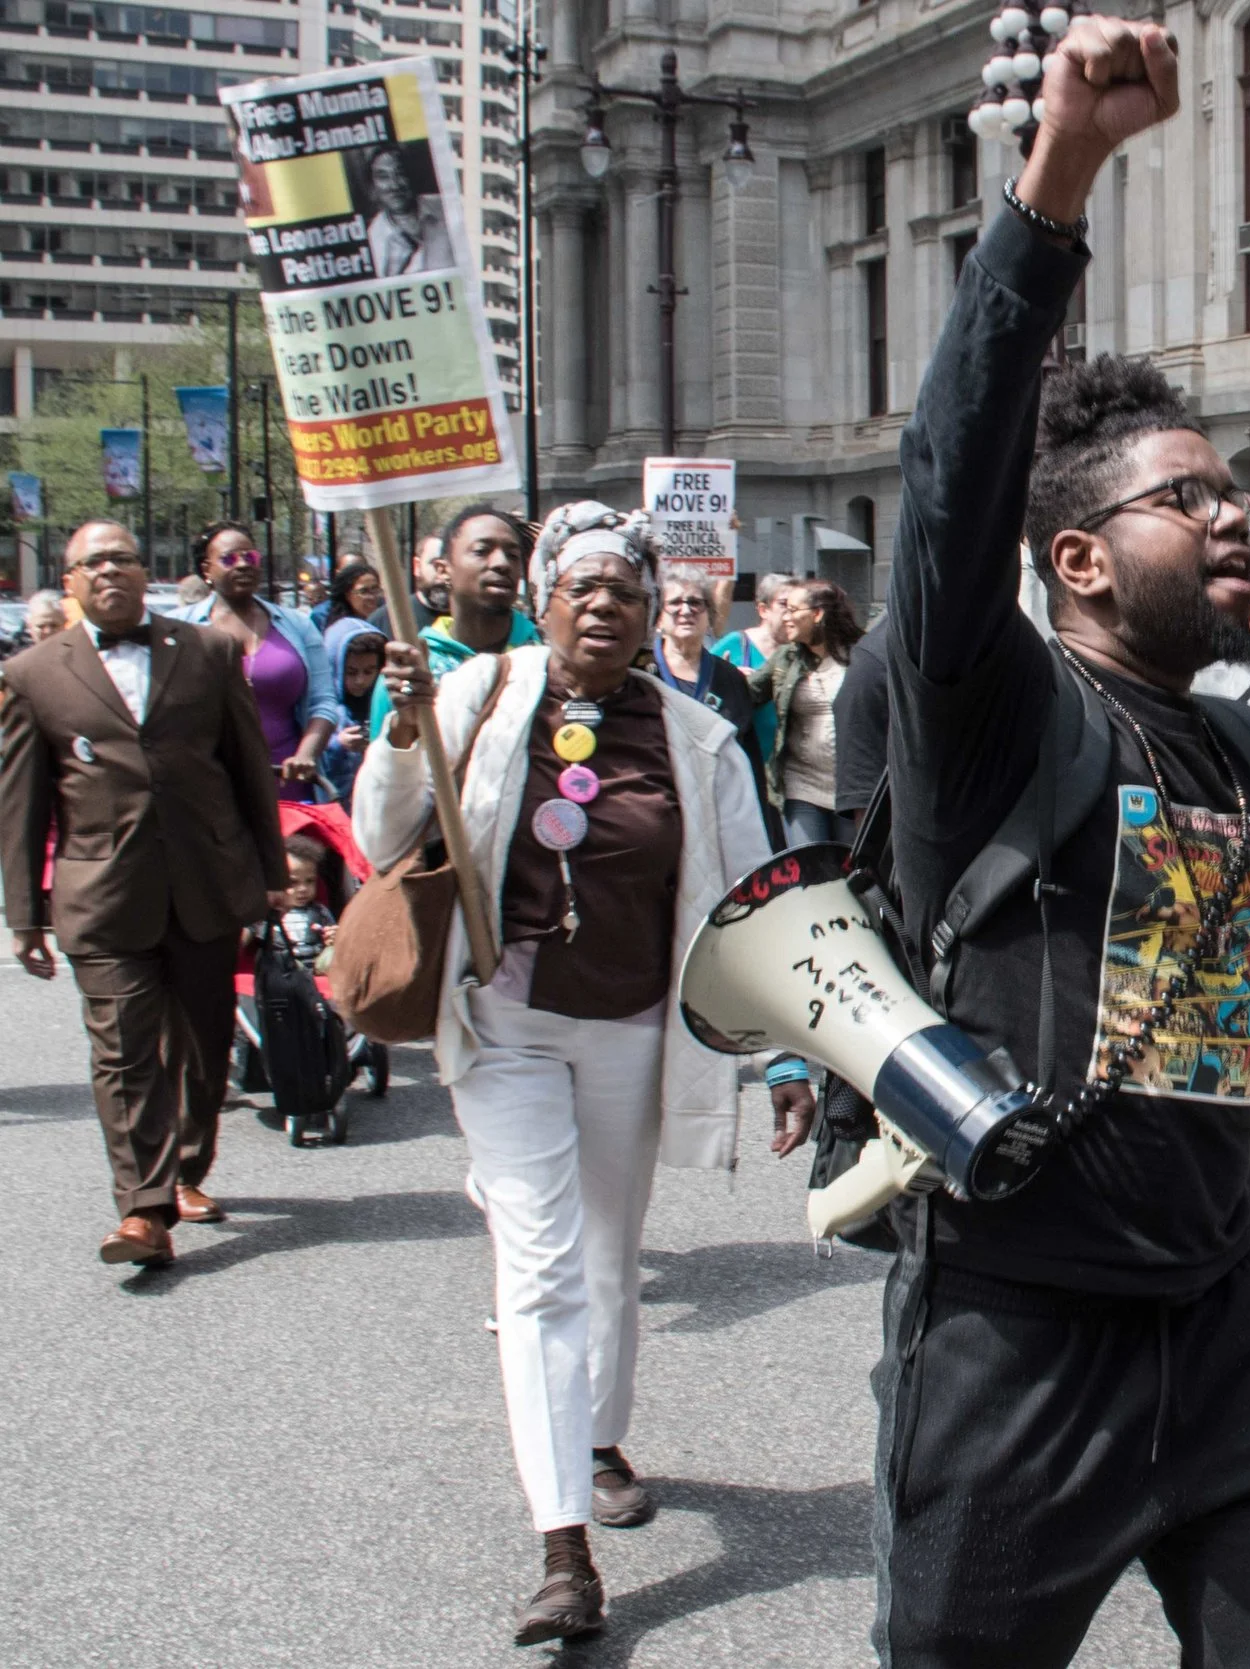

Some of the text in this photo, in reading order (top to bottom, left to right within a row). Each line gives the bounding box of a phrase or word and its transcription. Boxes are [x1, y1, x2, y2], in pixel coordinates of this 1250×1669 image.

[298, 84, 388, 120] Mumia
[250, 115, 388, 161] Abu-Jamal!
[271, 214, 366, 252] Leonard
[282, 246, 372, 286] Peltier!
[322, 288, 416, 330] MOVE
[423, 281, 455, 314] 9!
[327, 337, 413, 372] Down
[324, 373, 420, 413] Walls!
[334, 415, 410, 450] World
[414, 406, 487, 439] Party
[372, 439, 499, 473] workers.org
[673, 473, 710, 490] FREE
[655, 494, 727, 512] MOVE 9!
[666, 520, 716, 532] FREE ALL
